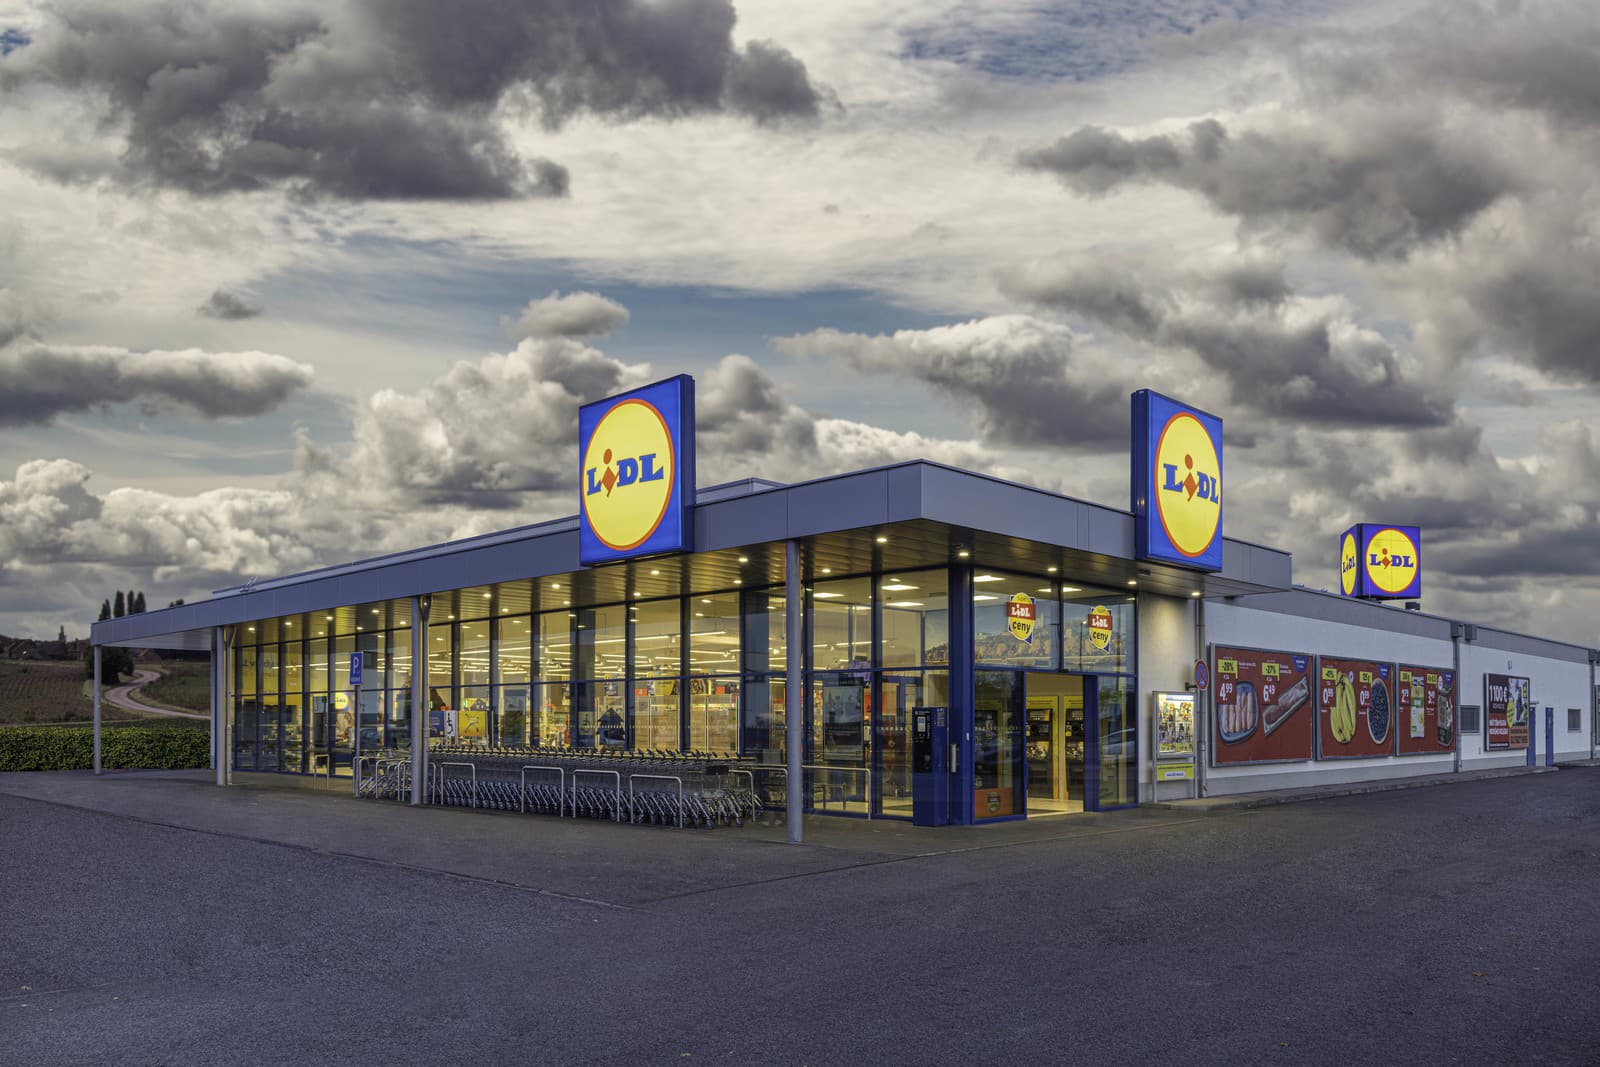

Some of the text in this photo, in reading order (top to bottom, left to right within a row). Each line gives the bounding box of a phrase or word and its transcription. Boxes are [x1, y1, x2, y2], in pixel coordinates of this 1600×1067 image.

[1012, 621, 1031, 634] ceny
[1092, 631, 1109, 643] ceny
[353, 656, 359, 674] P
